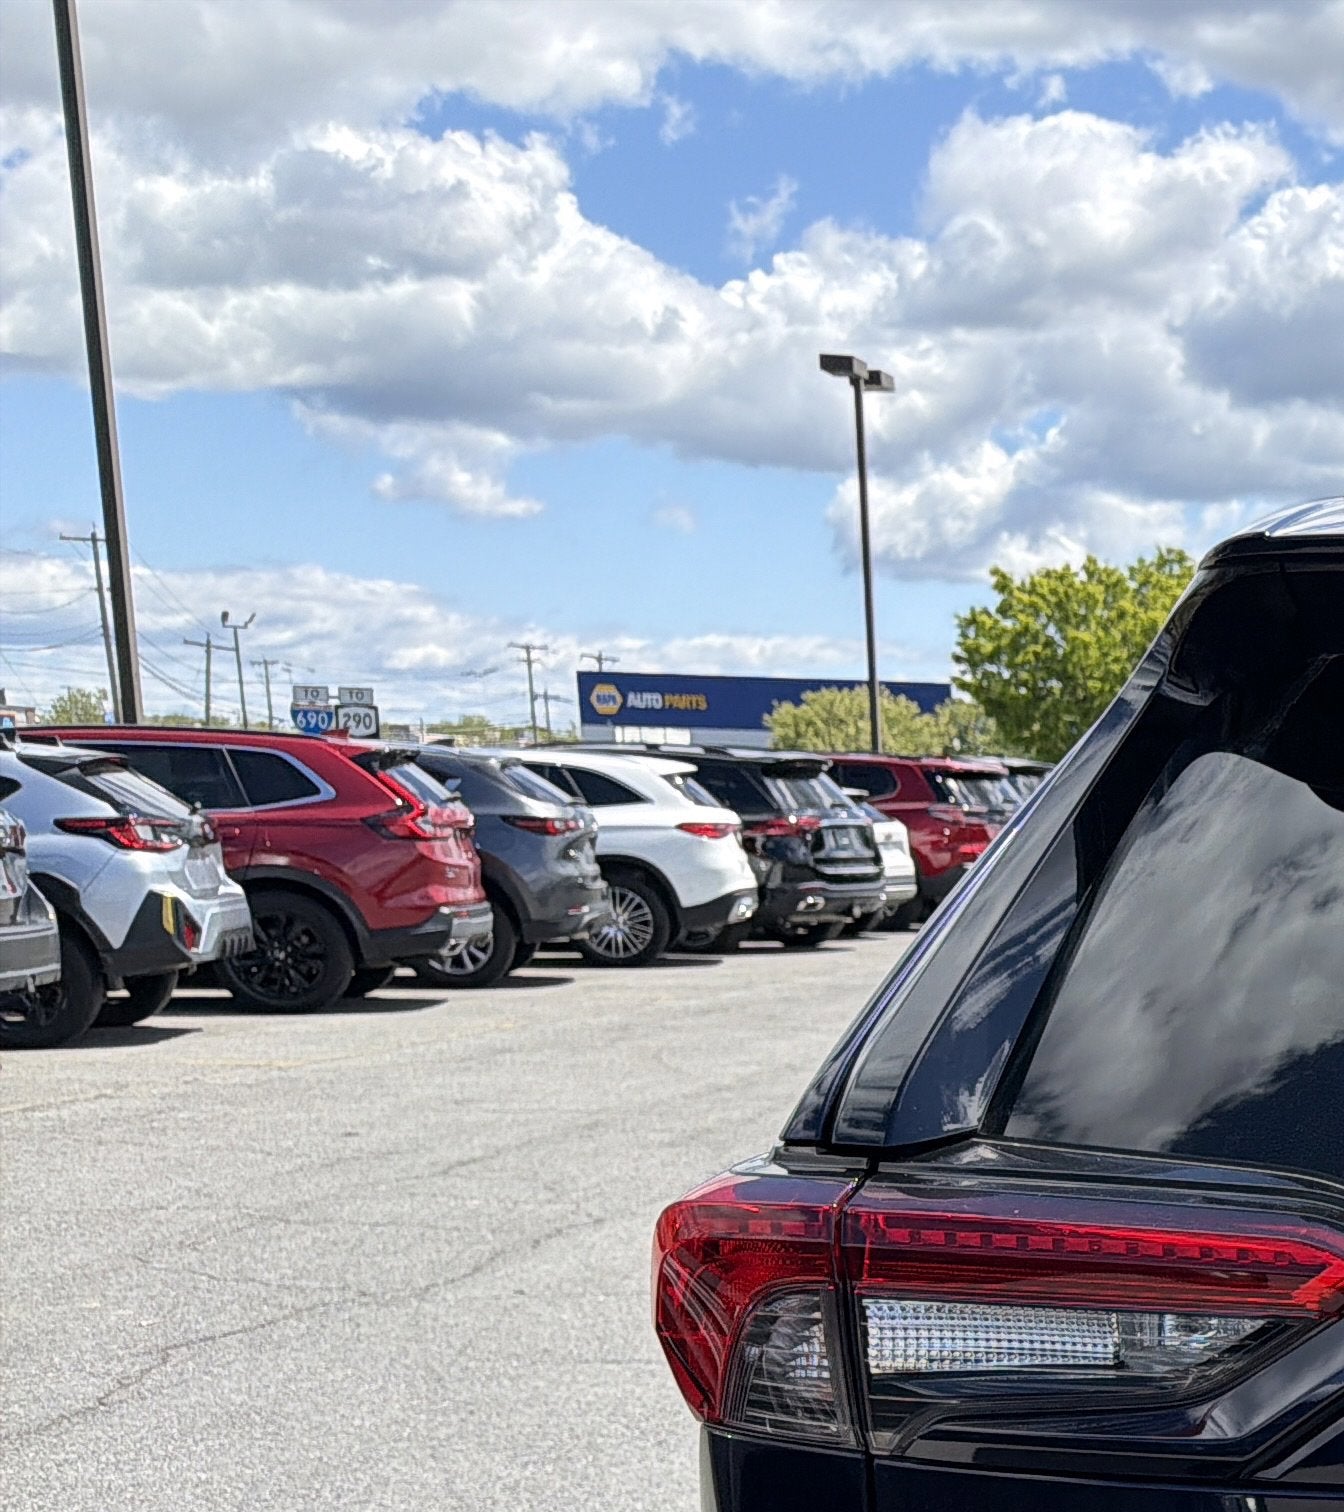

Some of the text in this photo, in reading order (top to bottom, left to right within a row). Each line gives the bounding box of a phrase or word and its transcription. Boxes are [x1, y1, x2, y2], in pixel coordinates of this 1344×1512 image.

[626, 691, 708, 710] AUTO PARTS
[297, 711, 328, 730] 690
[343, 712, 372, 730] 290
